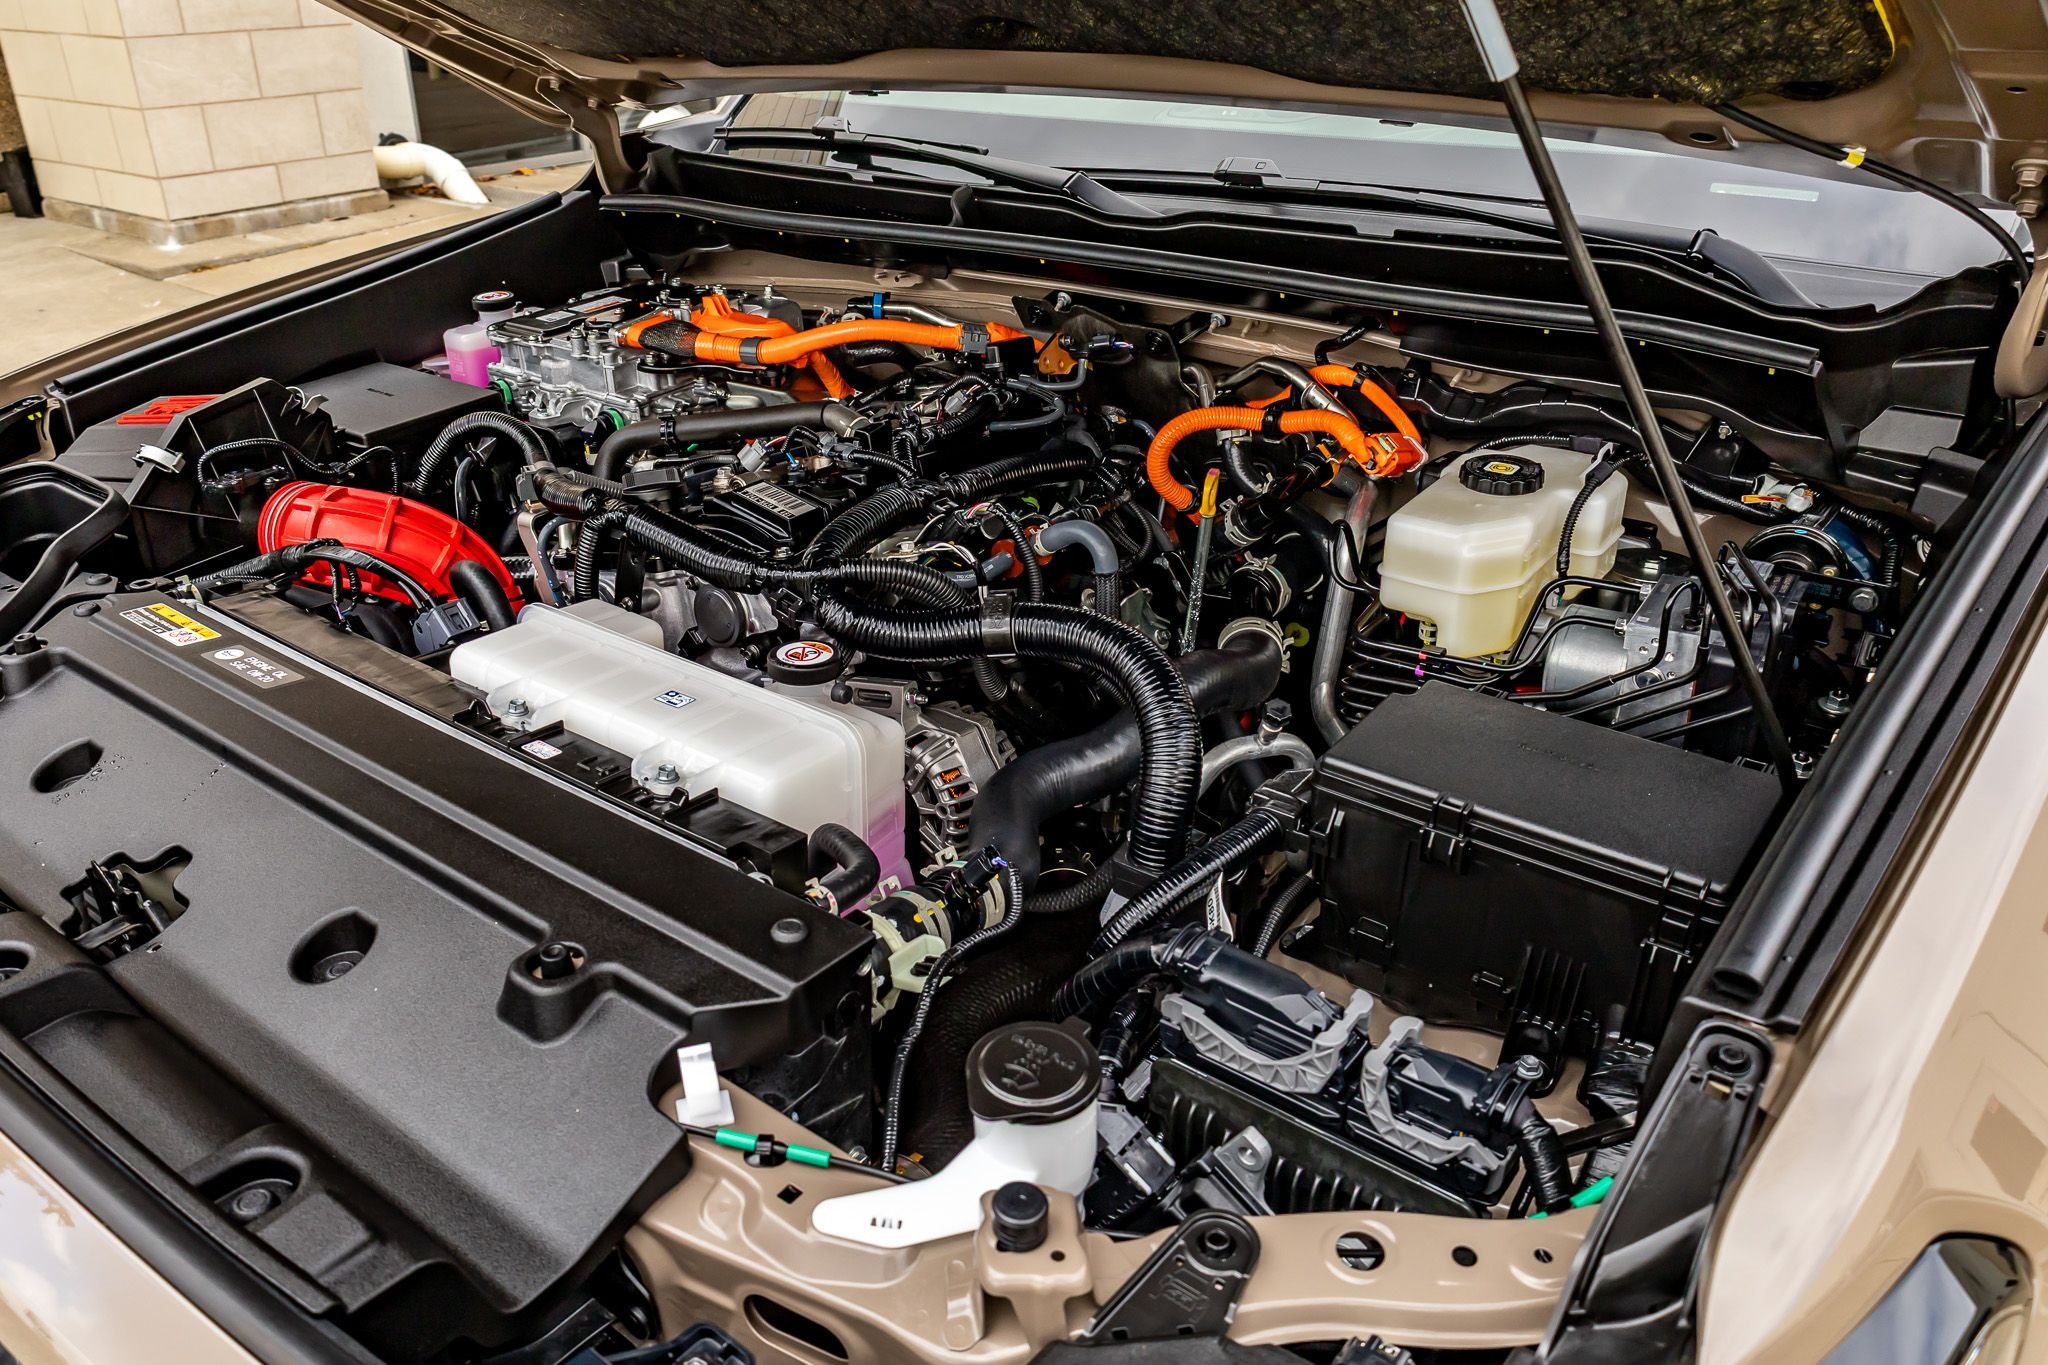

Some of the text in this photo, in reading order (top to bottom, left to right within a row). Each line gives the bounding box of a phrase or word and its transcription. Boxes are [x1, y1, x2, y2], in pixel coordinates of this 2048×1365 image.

[228, 660, 275, 683] SAE 0W-20
[243, 656, 289, 680] ENGINE OIL
